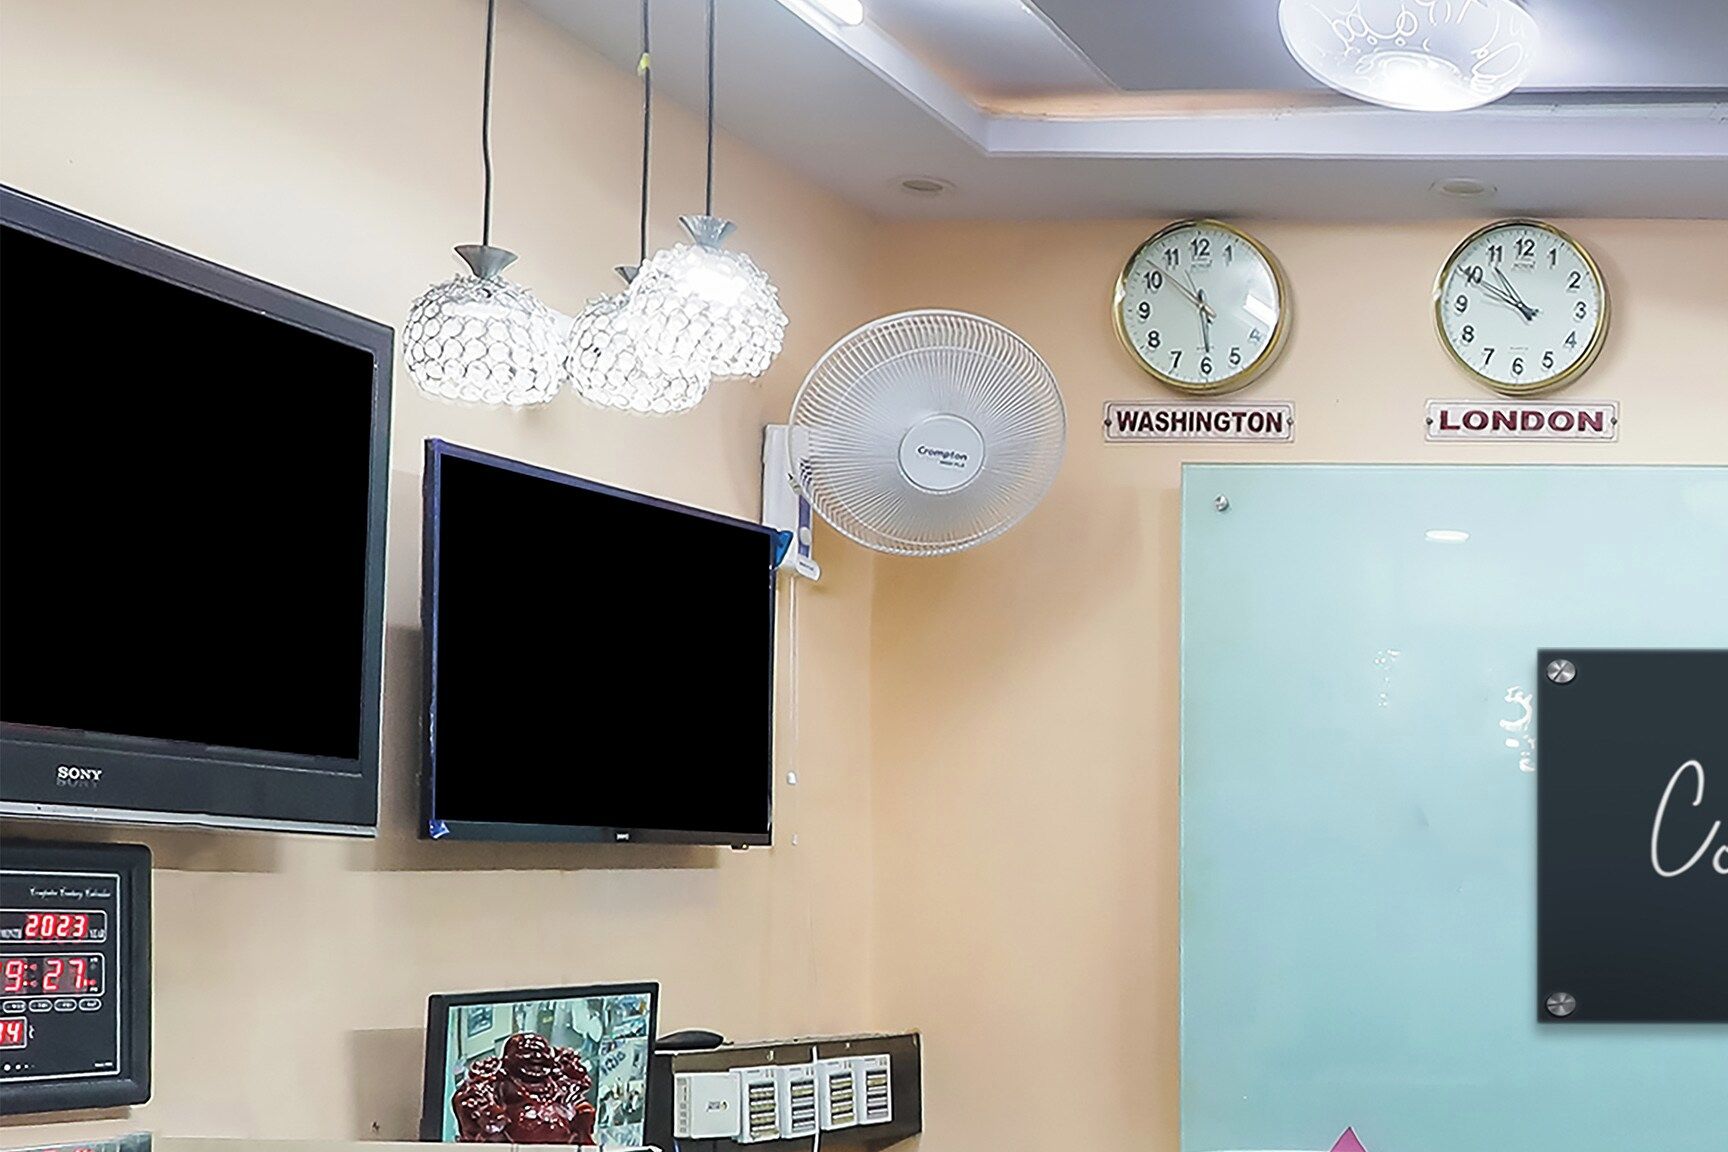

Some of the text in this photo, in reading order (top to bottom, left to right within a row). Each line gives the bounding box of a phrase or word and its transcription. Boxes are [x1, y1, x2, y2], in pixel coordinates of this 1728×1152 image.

[1191, 238, 1210, 256] 12
[1224, 245, 1232, 260] 1
[1488, 245, 1502, 262] 11
[1516, 239, 1535, 256] 12
[1165, 249, 1179, 265] 11
[1549, 249, 1556, 265] 1
[1144, 271, 1162, 289] 10
[1464, 266, 1483, 284] 10
[1569, 271, 1581, 288] 2
[1139, 302, 1150, 319] 9
[1456, 295, 1468, 312] 9
[1575, 302, 1586, 319] 3
[1148, 331, 1160, 348] 8
[1462, 325, 1474, 342] 8
[1565, 331, 1577, 348] 4
[1171, 351, 1182, 368] 7
[1229, 348, 1241, 364] 5
[1484, 348, 1494, 364] 7
[1542, 352, 1553, 369] 5
[1201, 357, 1212, 374] 6
[1512, 358, 1523, 375] 6
[1117, 411, 1282, 432] WASHINGTON
[1440, 411, 1603, 432] LONDON
[918, 446, 967, 460] Crompton
[58, 766, 102, 780] SONY
[25, 914, 86, 937] 2023
